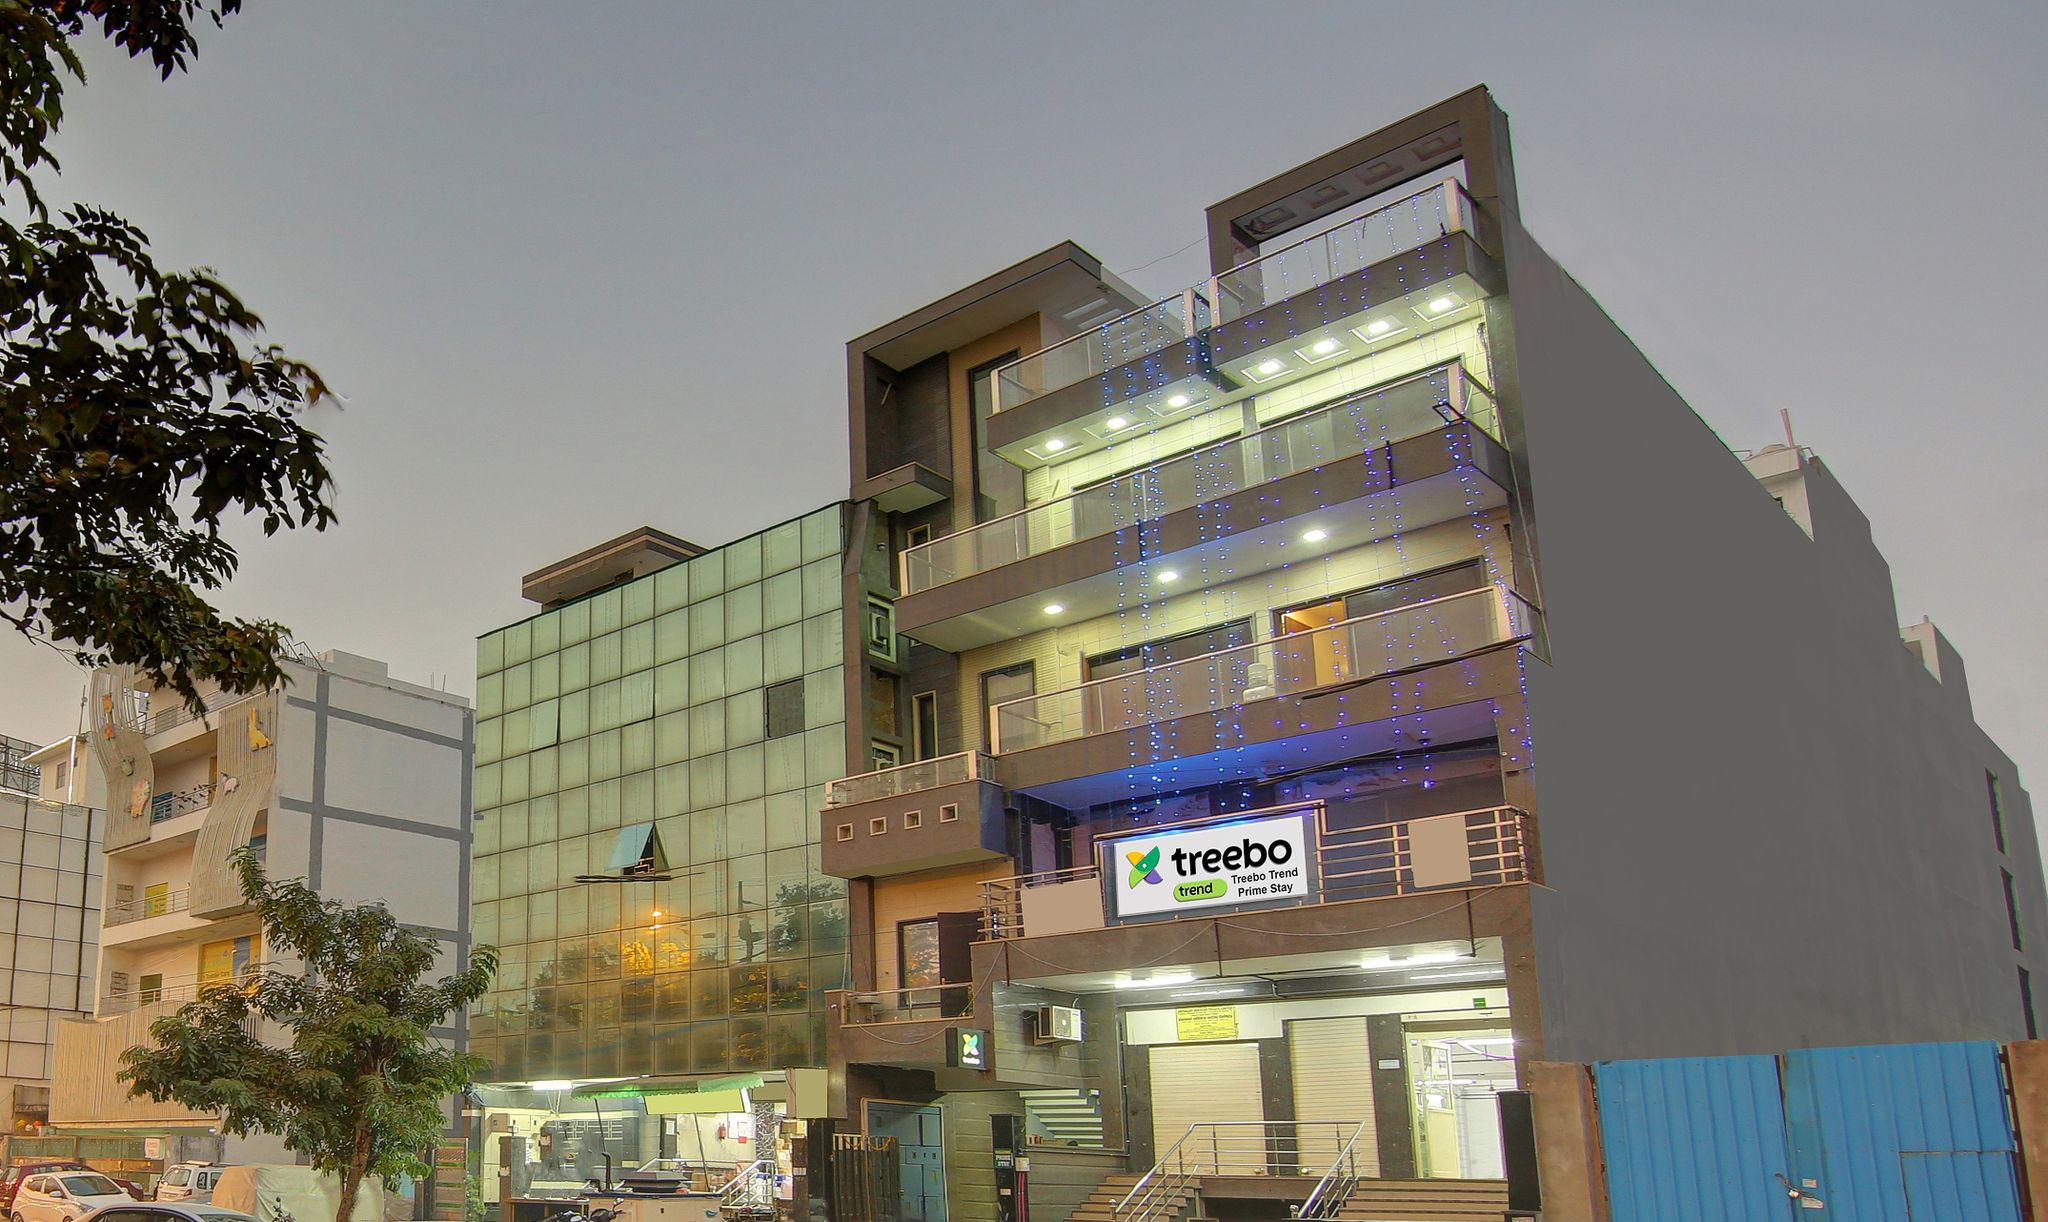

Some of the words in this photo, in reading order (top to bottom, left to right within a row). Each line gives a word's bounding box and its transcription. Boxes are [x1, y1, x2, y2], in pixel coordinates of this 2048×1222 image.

[1171, 838, 1292, 876] treebo
[1231, 873, 1266, 884] Treebo
[1269, 867, 1298, 880] Trend
[1178, 883, 1213, 897] trend
[1238, 886, 1268, 897] Prime
[1270, 884, 1294, 894] Stay
